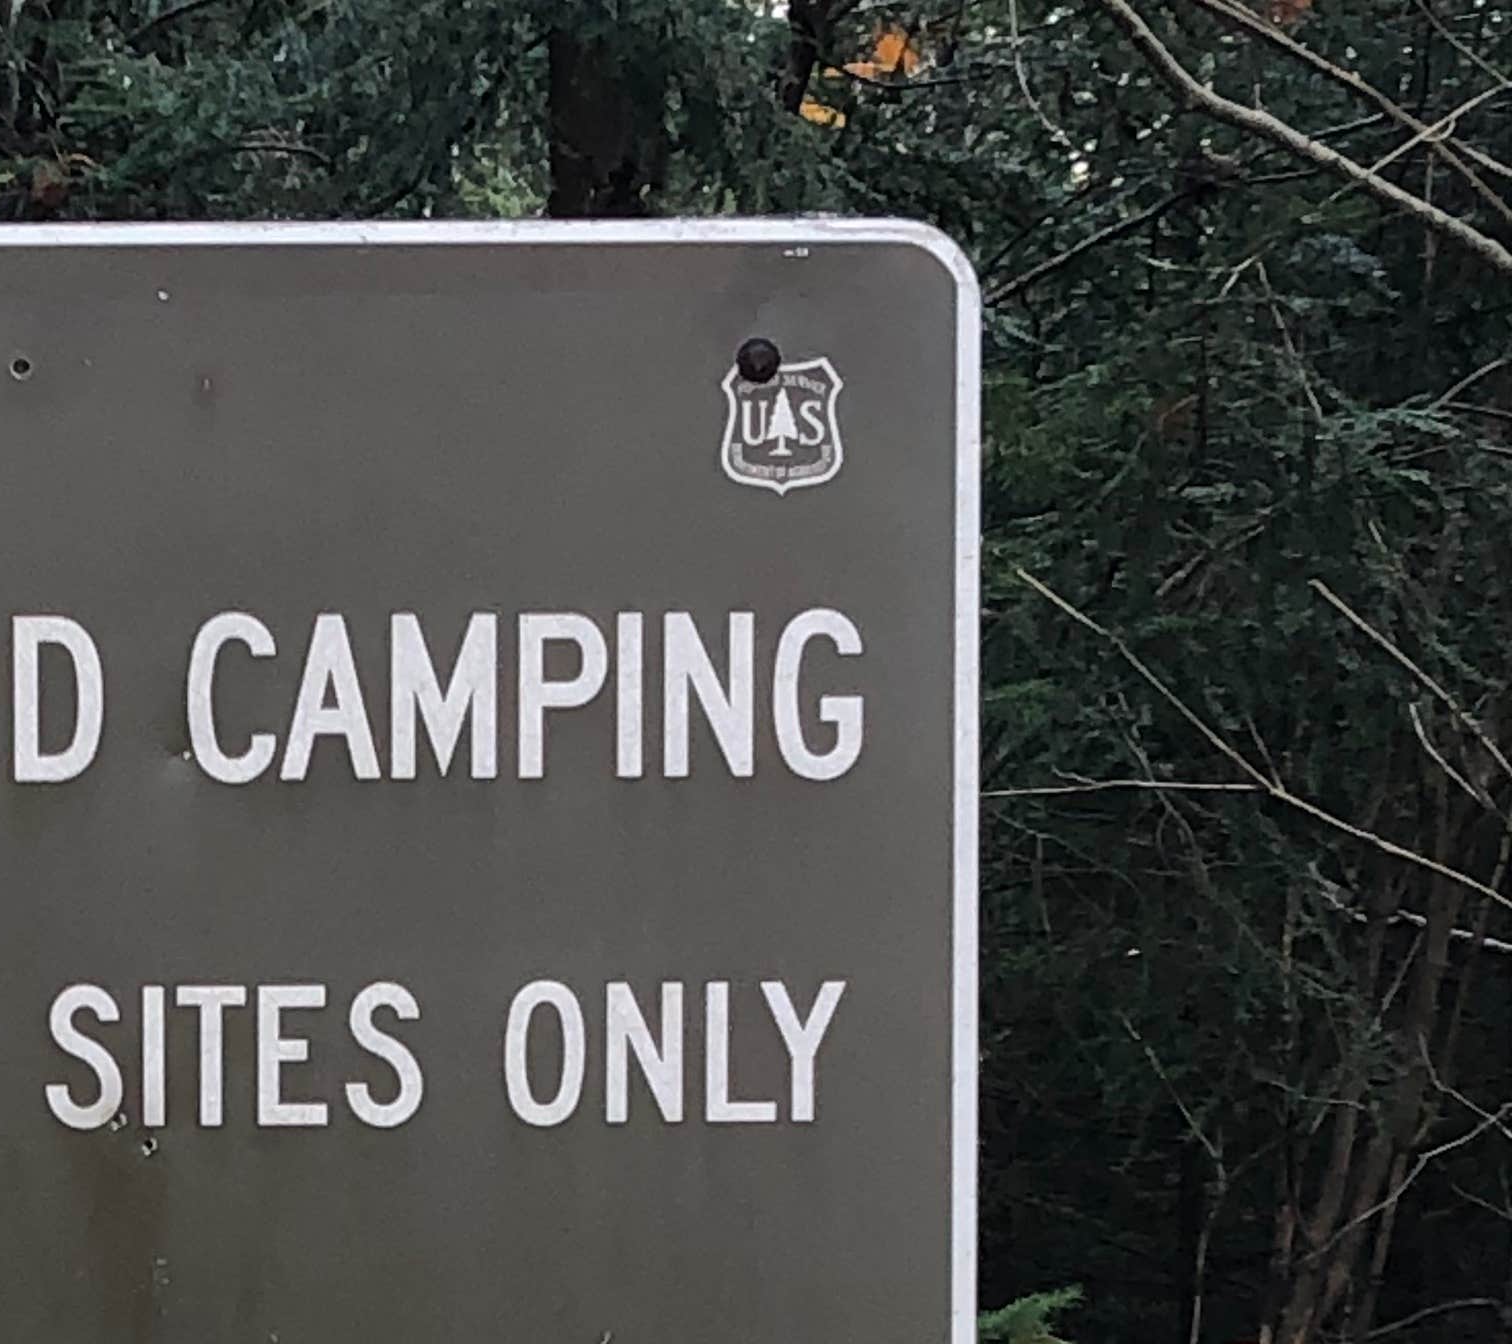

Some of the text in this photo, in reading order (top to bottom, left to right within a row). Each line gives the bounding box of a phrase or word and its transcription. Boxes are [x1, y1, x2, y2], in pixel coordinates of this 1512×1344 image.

[188, 609, 865, 785] CAMPING
[46, 981, 424, 1131] SITES
[504, 979, 847, 1128] ONLY
